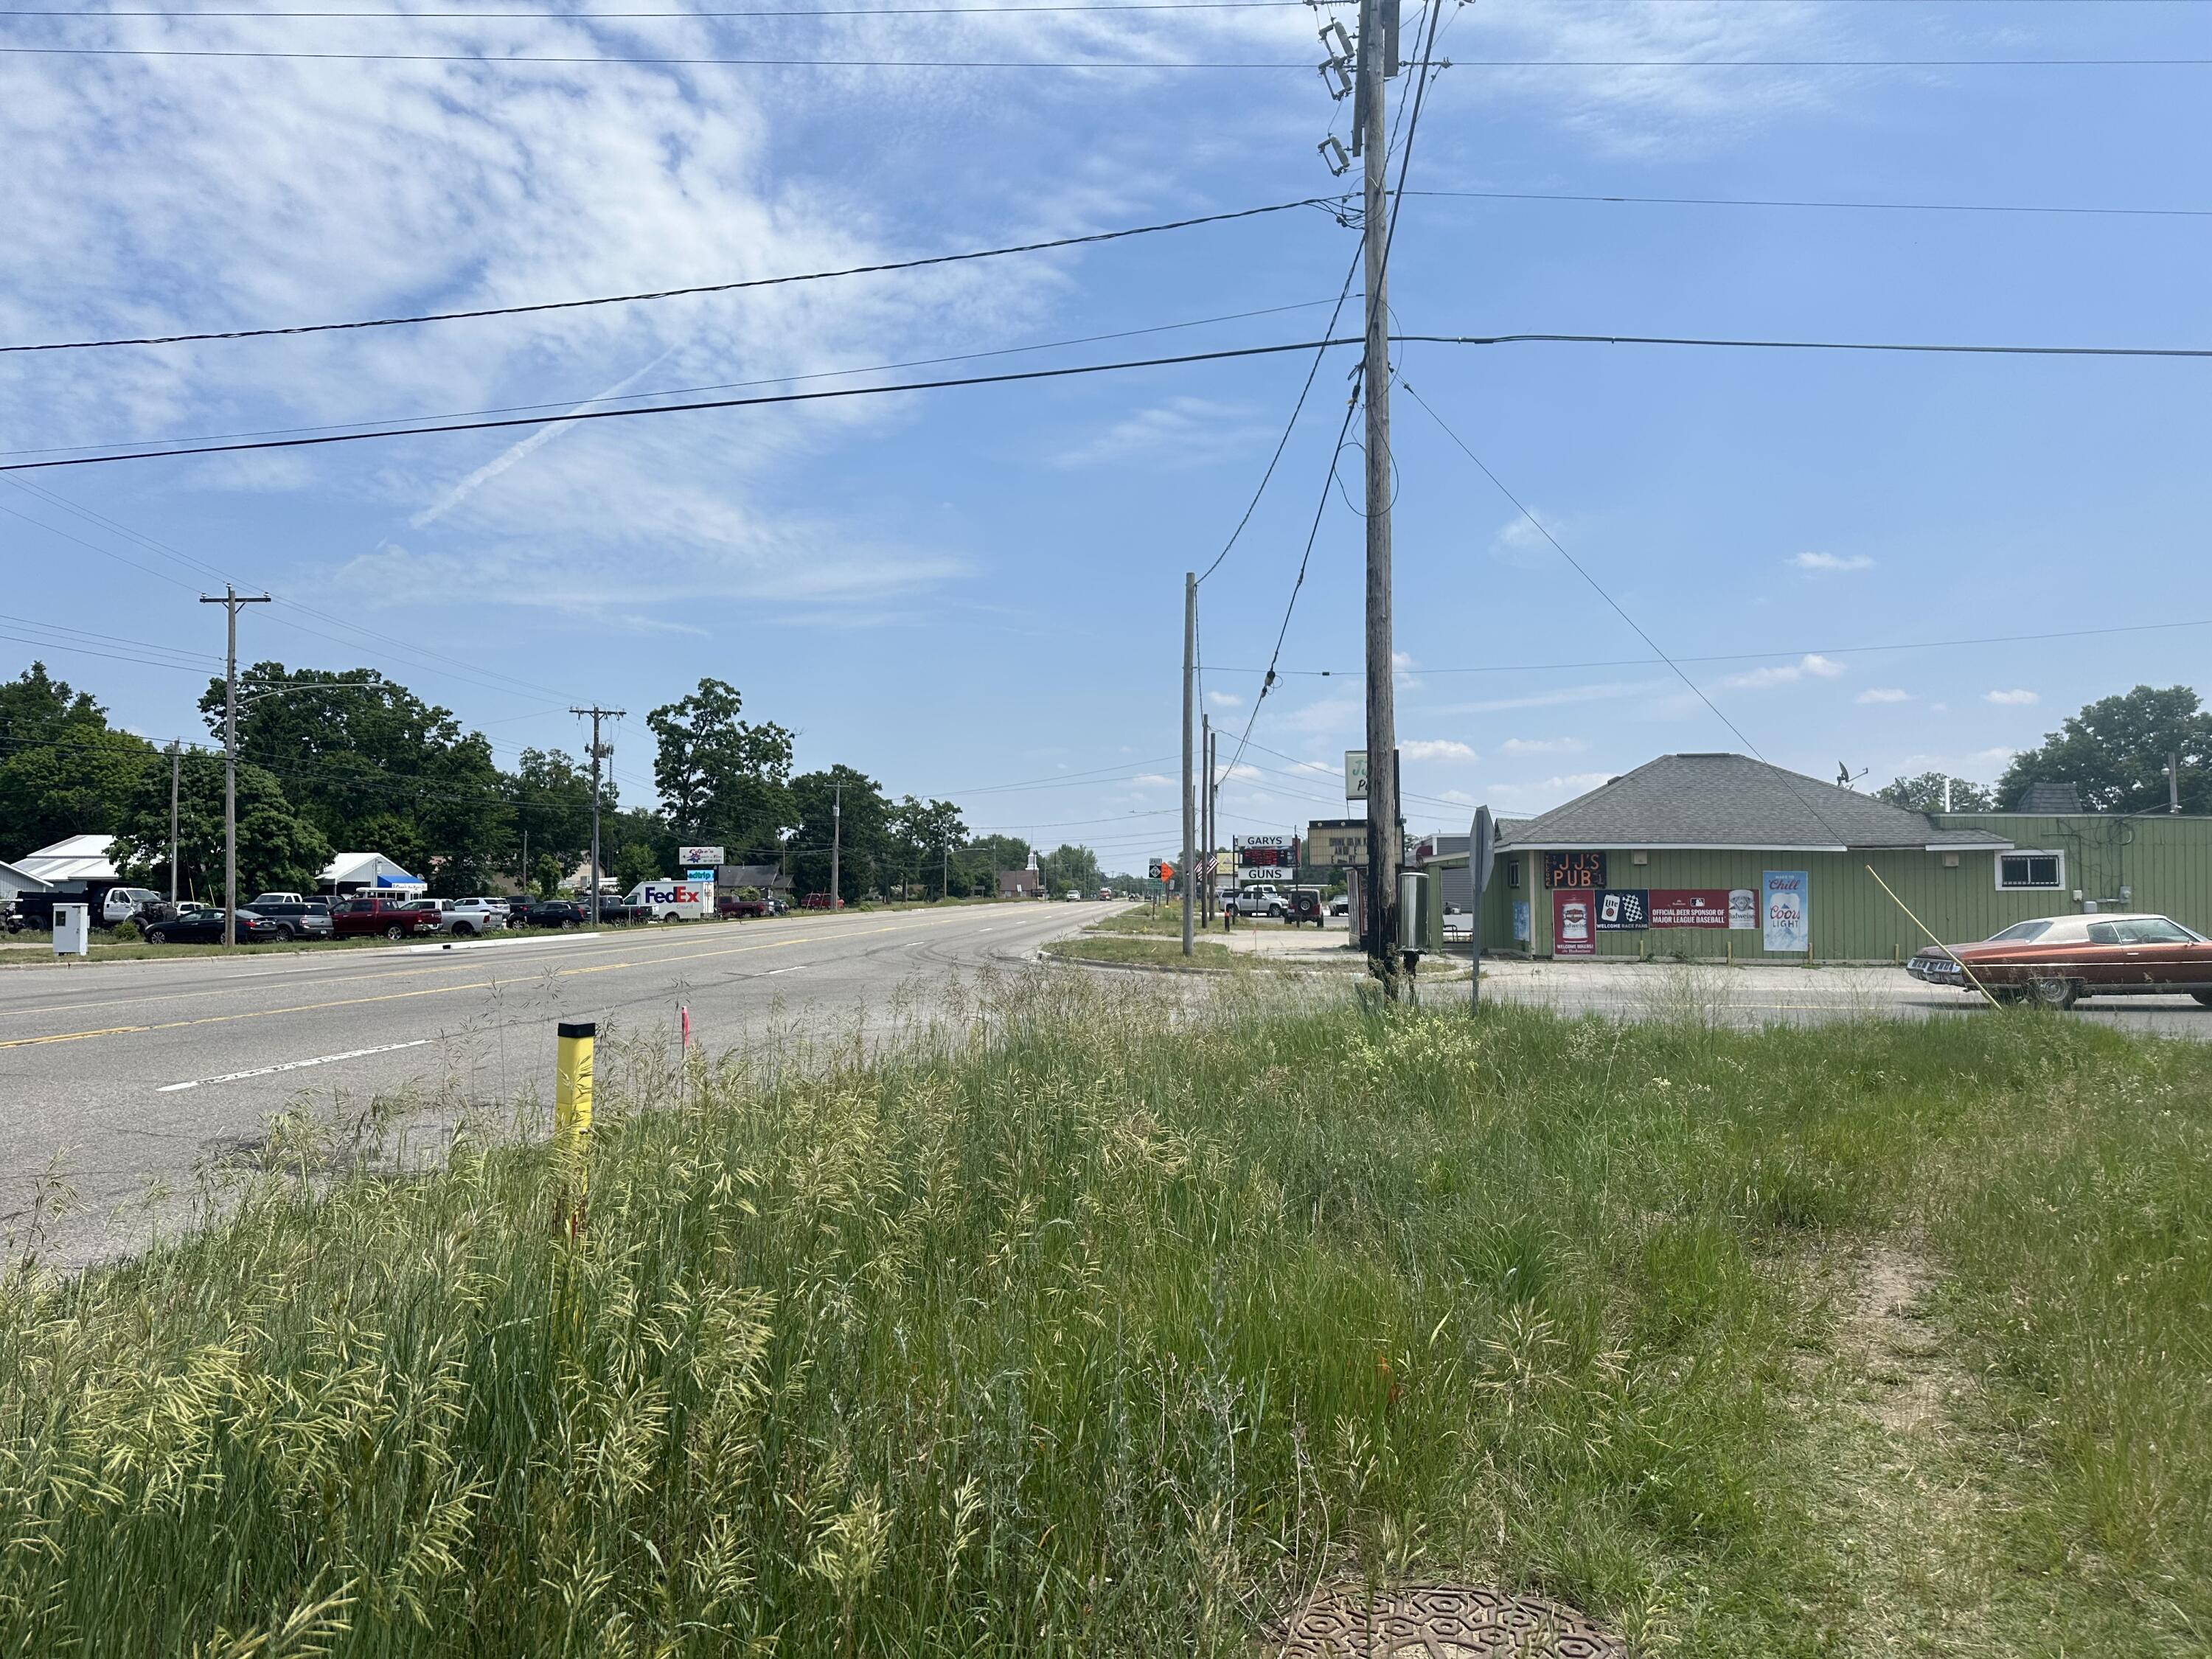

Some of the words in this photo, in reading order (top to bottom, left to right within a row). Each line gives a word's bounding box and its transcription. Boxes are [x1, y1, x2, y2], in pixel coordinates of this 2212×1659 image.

[1247, 836, 1282, 845] GARYS
[1559, 854, 1599, 870] JJ'S
[1248, 869, 1282, 878] GUNS
[1554, 870, 1591, 886] PUB
[1769, 878, 1801, 890] Chill
[645, 886, 700, 903] FedEx
